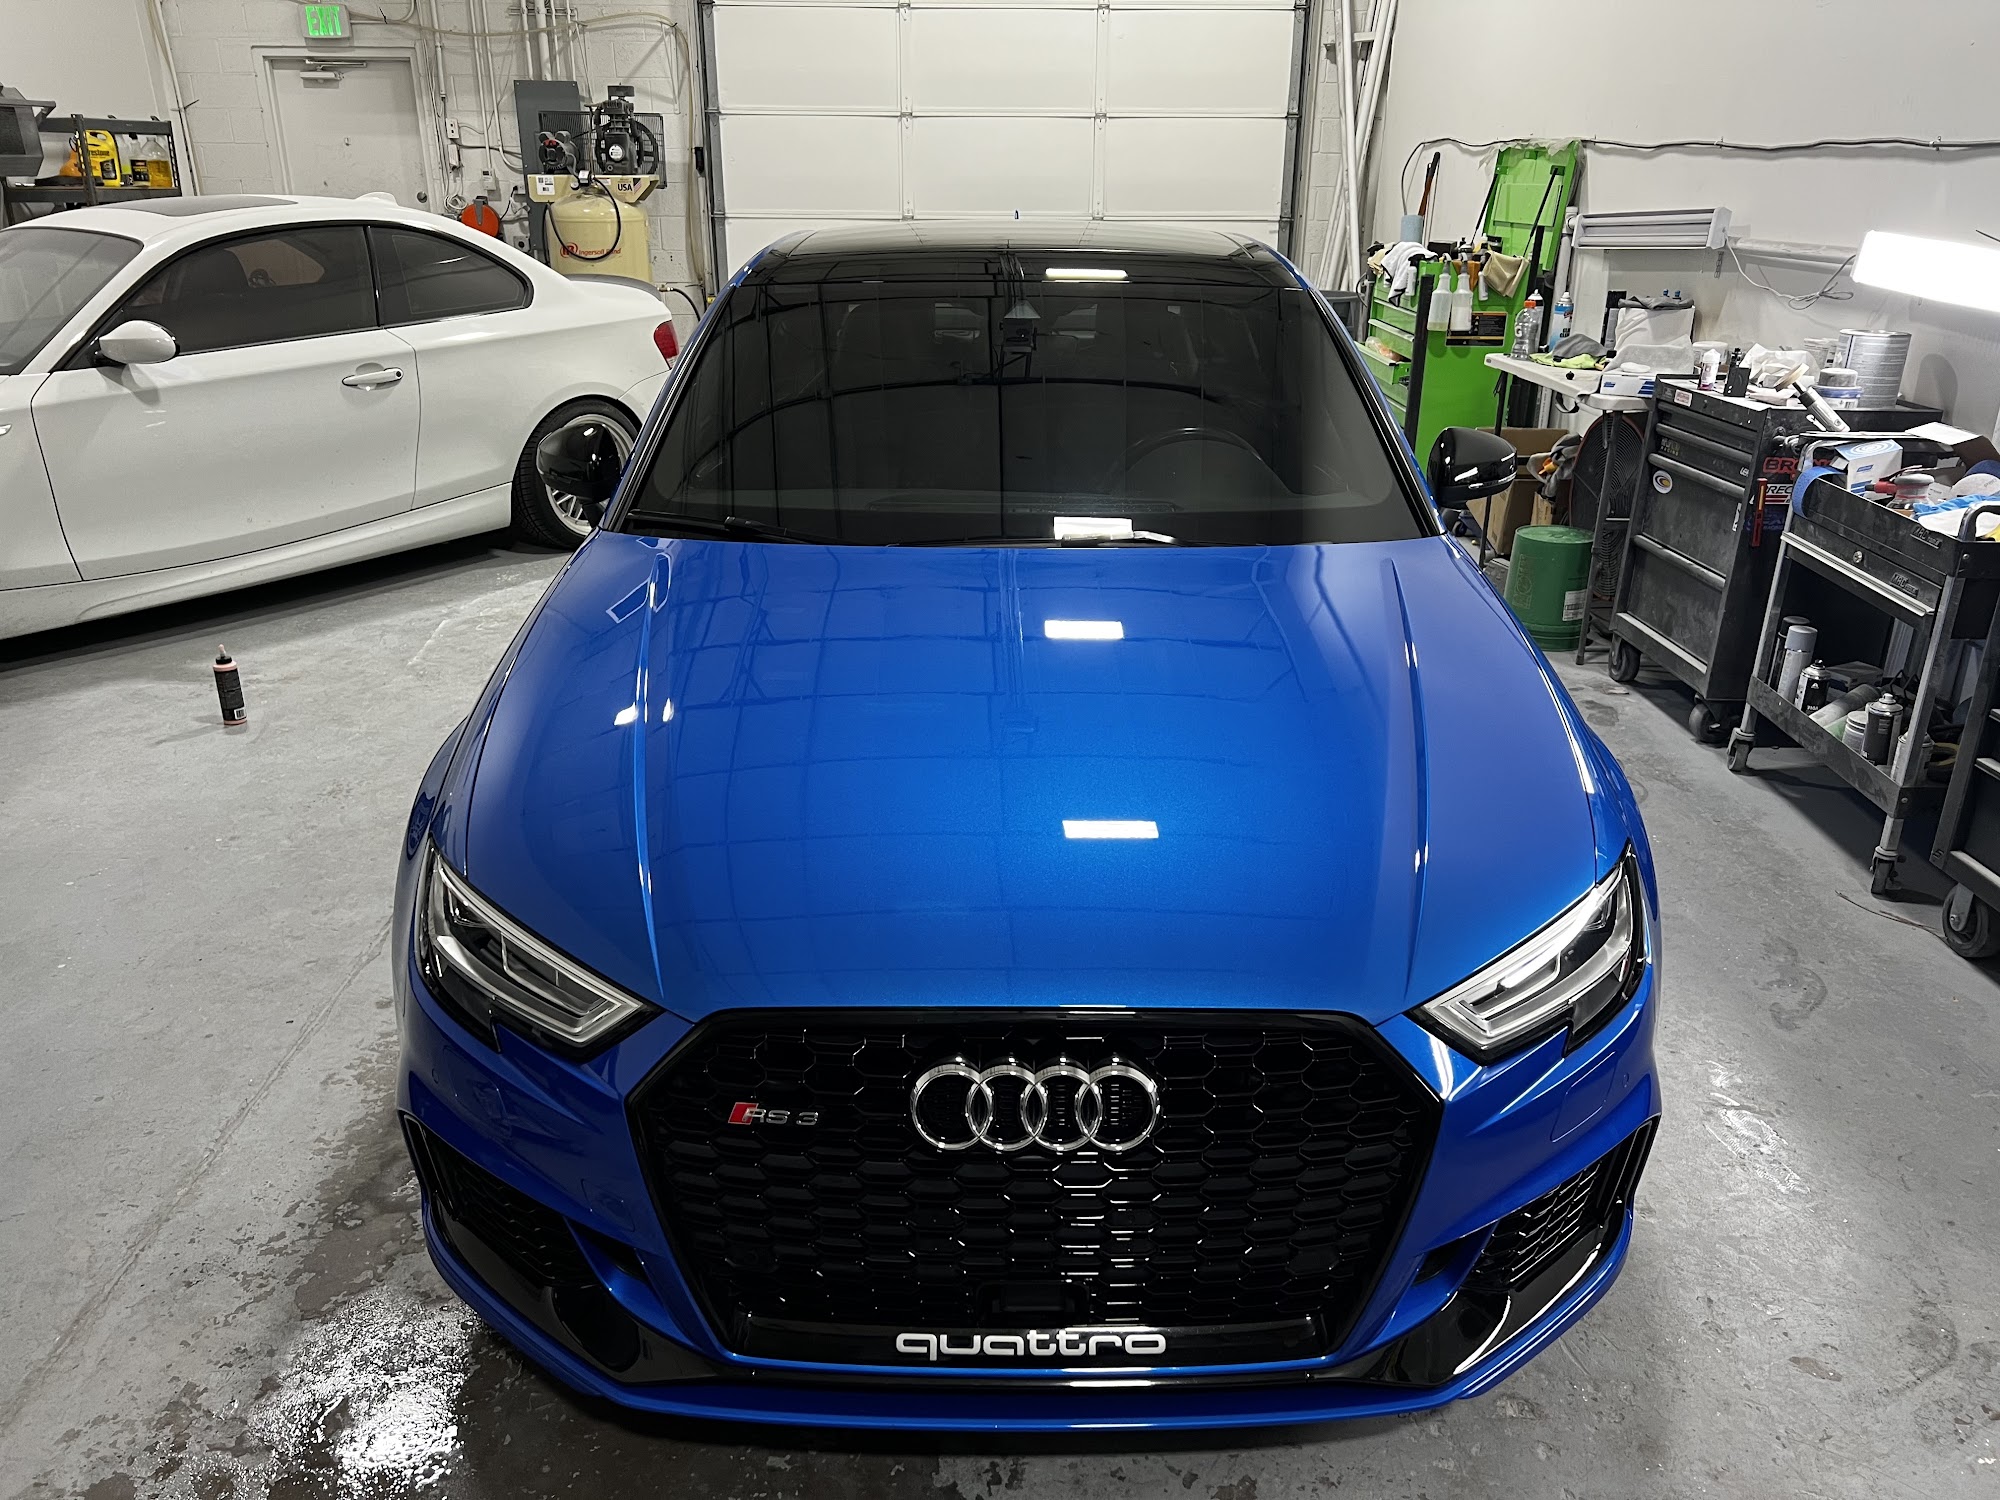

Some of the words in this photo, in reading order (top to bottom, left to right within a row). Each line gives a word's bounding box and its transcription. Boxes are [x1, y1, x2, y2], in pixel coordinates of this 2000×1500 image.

[305, 6, 341, 35] EXIT
[617, 183, 633, 191] USA
[579, 248, 605, 256] Ingersoll
[741, 1107, 790, 1124] RS
[796, 1112, 819, 1125] 3
[896, 1329, 1166, 1361] quattro
